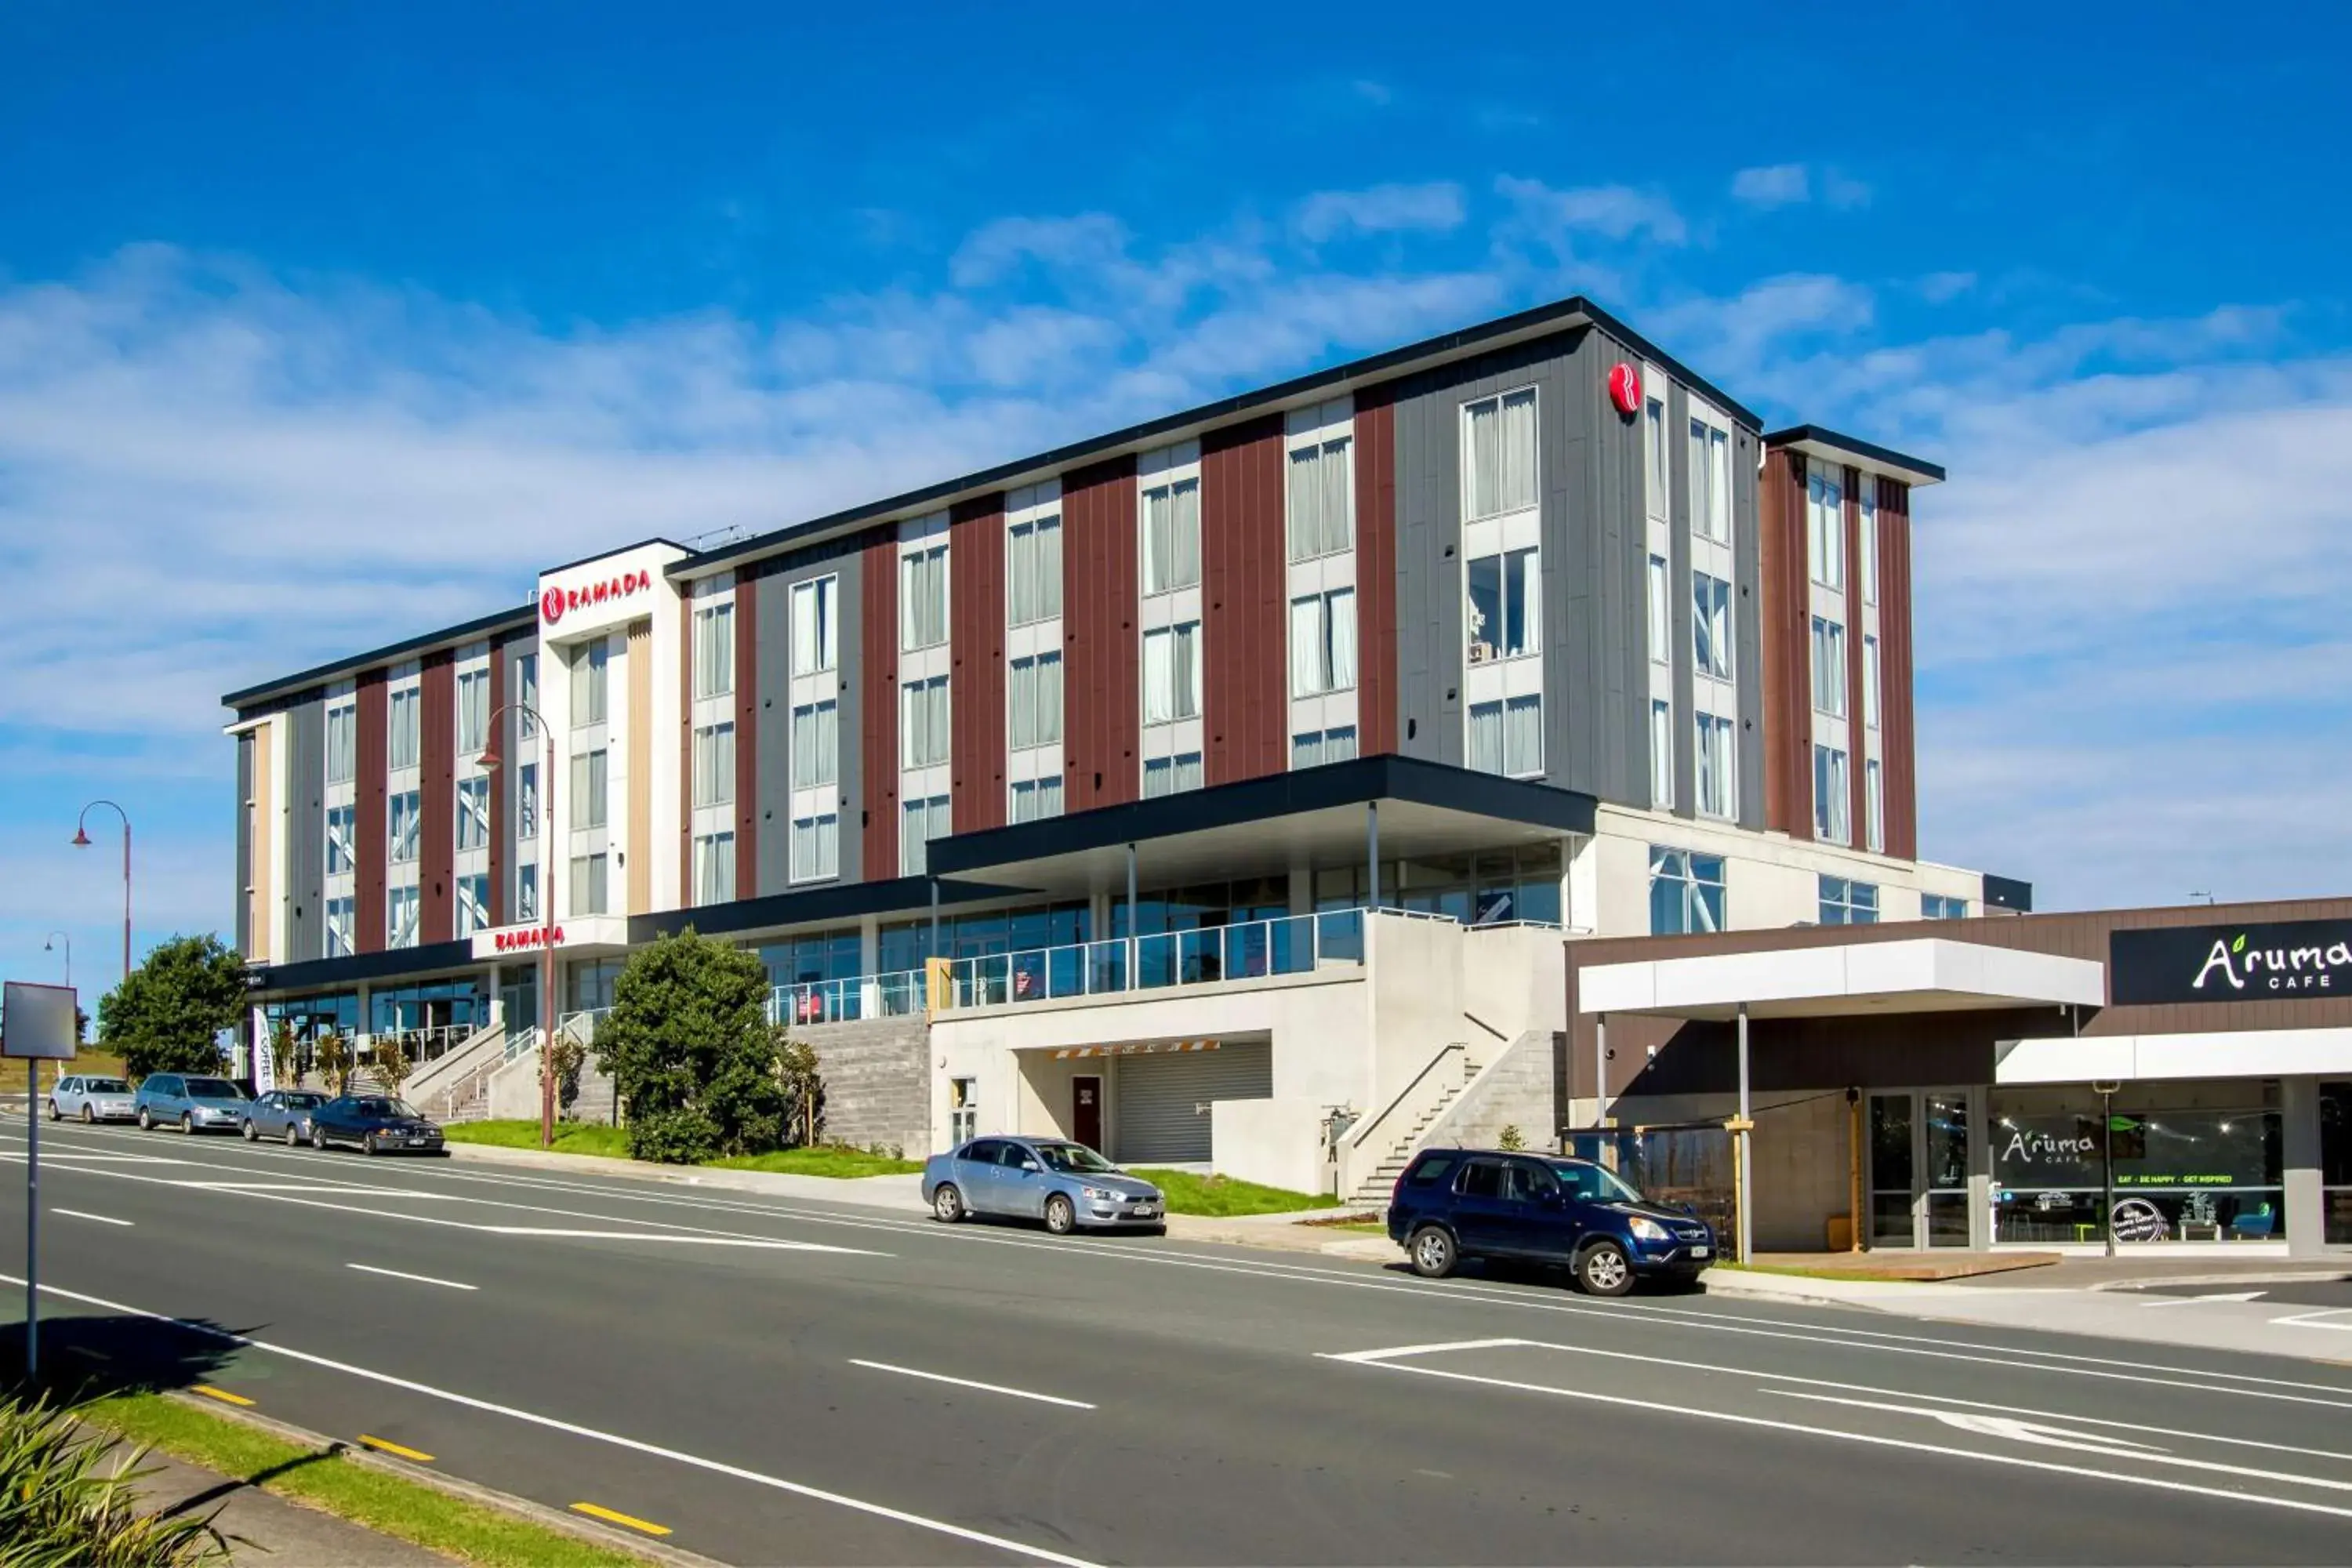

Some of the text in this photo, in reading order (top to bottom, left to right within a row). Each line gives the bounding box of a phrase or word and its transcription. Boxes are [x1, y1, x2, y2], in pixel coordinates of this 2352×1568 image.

[568, 570, 651, 609] RAMADA
[2192, 938, 2352, 989] Aruma
[2268, 975, 2330, 989] CAFE
[260, 1036, 270, 1079] COFFEE
[2001, 1132, 2095, 1163] Aruma
